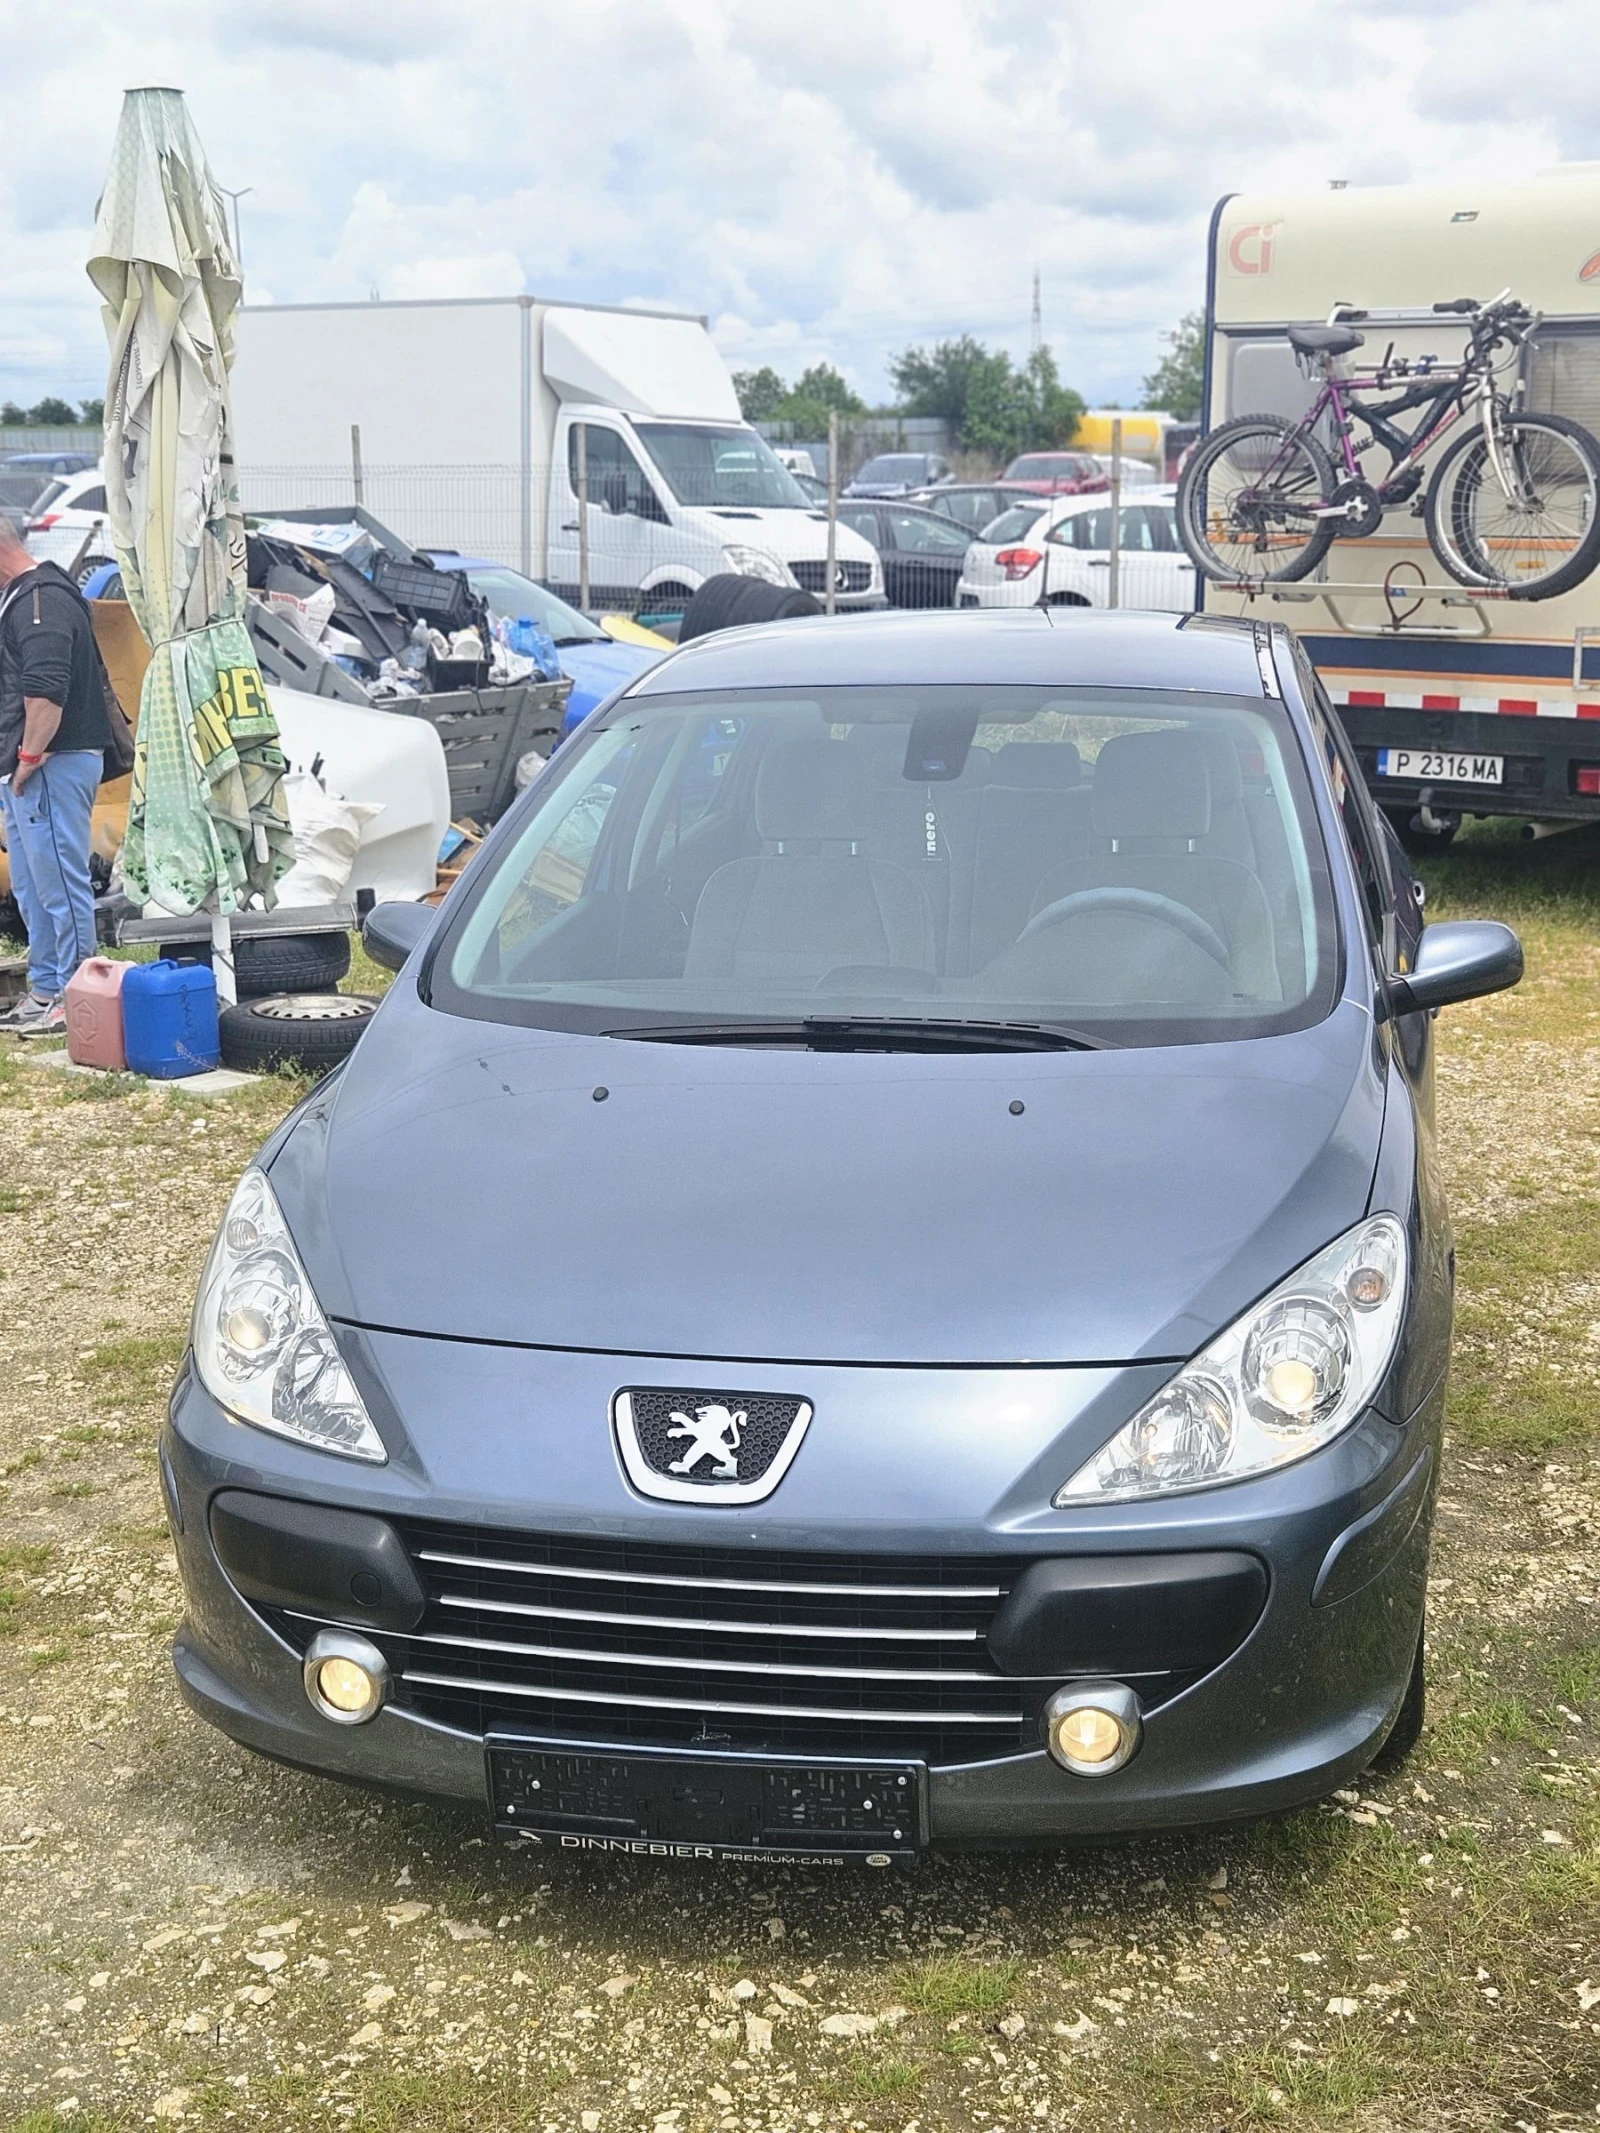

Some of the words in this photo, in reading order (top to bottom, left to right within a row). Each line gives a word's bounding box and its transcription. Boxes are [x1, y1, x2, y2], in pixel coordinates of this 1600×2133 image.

[1229, 224, 1272, 275] Ci
[1397, 753, 1410, 773] P
[1420, 755, 1468, 778] 2316
[1472, 758, 1498, 780] MA
[925, 812, 936, 852] nero
[561, 1835, 713, 1859] DINNEBIER
